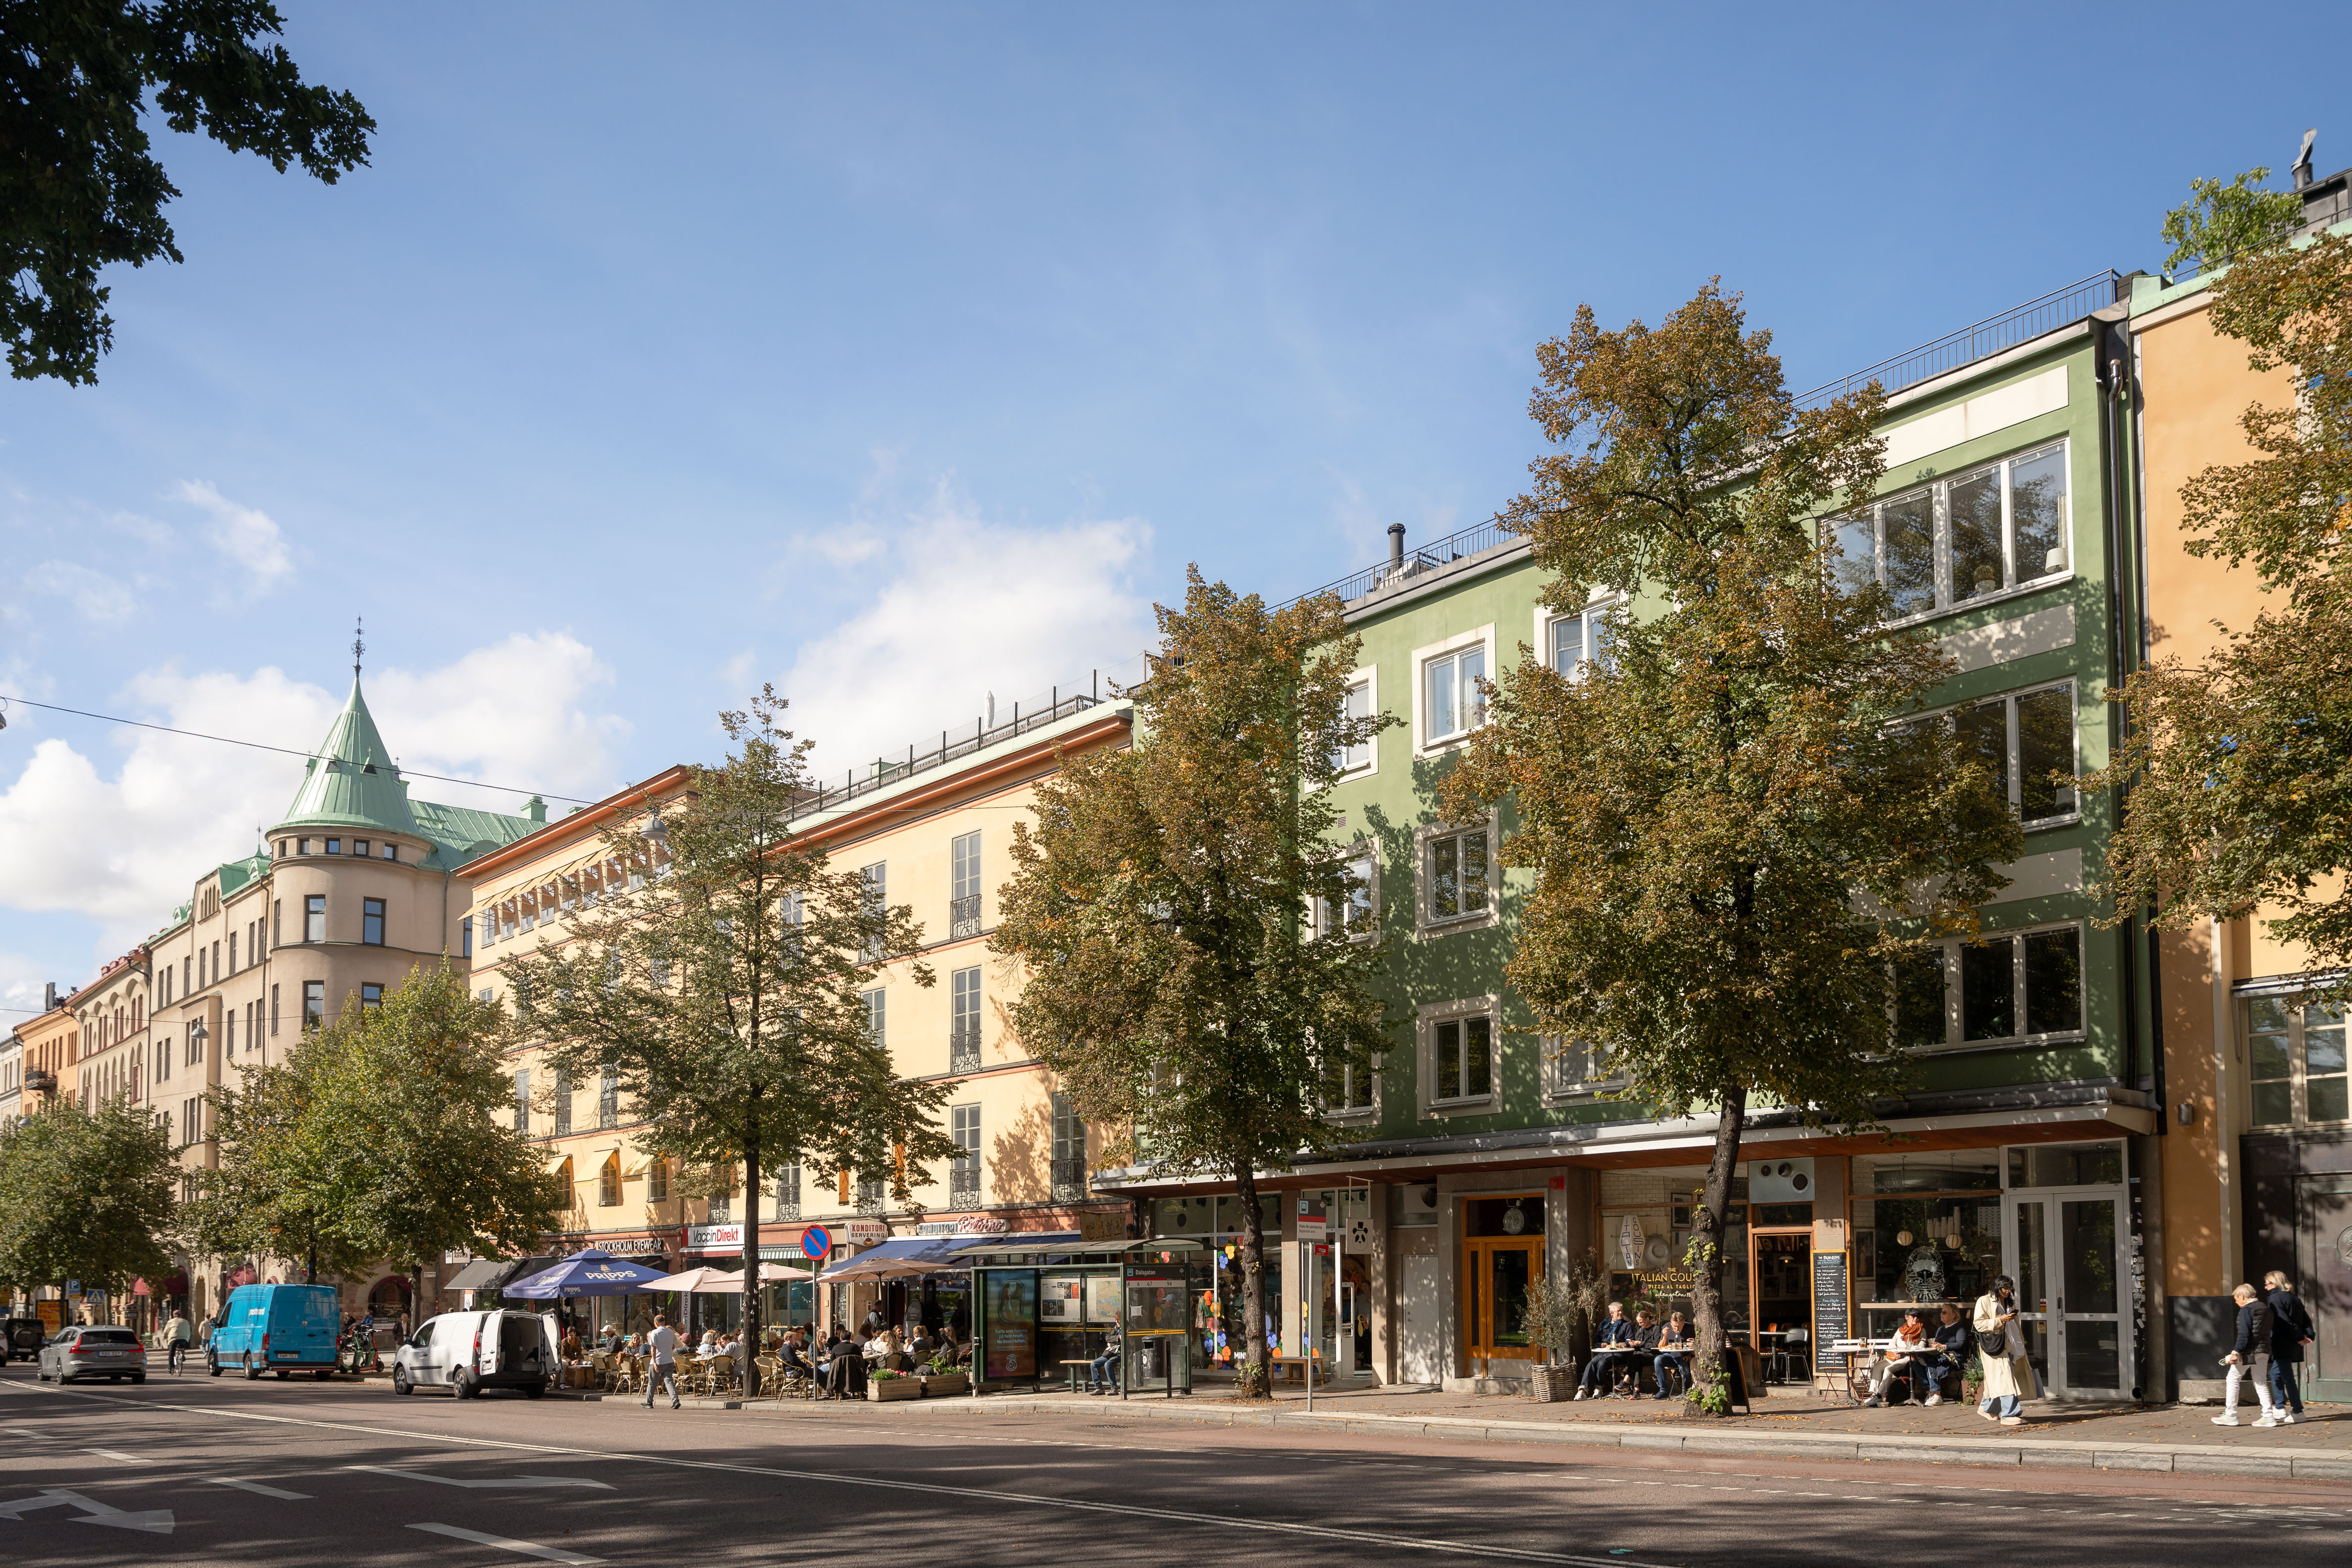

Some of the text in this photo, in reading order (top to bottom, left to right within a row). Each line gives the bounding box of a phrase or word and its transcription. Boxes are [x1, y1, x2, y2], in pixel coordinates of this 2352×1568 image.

[852, 1224, 885, 1232] KONDITORI
[918, 1214, 1005, 1234] KONDITORI Ritorno
[693, 1227, 738, 1243] VaccinDirekt
[1621, 1219, 1632, 1267] ITALIAN
[1633, 1217, 1644, 1266] COUSINS
[598, 1239, 661, 1252] STOCKHOLM EYEWEAR
[585, 1271, 637, 1280] PRIPPS
[1632, 1273, 1667, 1282] ITALIAN
[1006, 1354, 1018, 1372] 3
